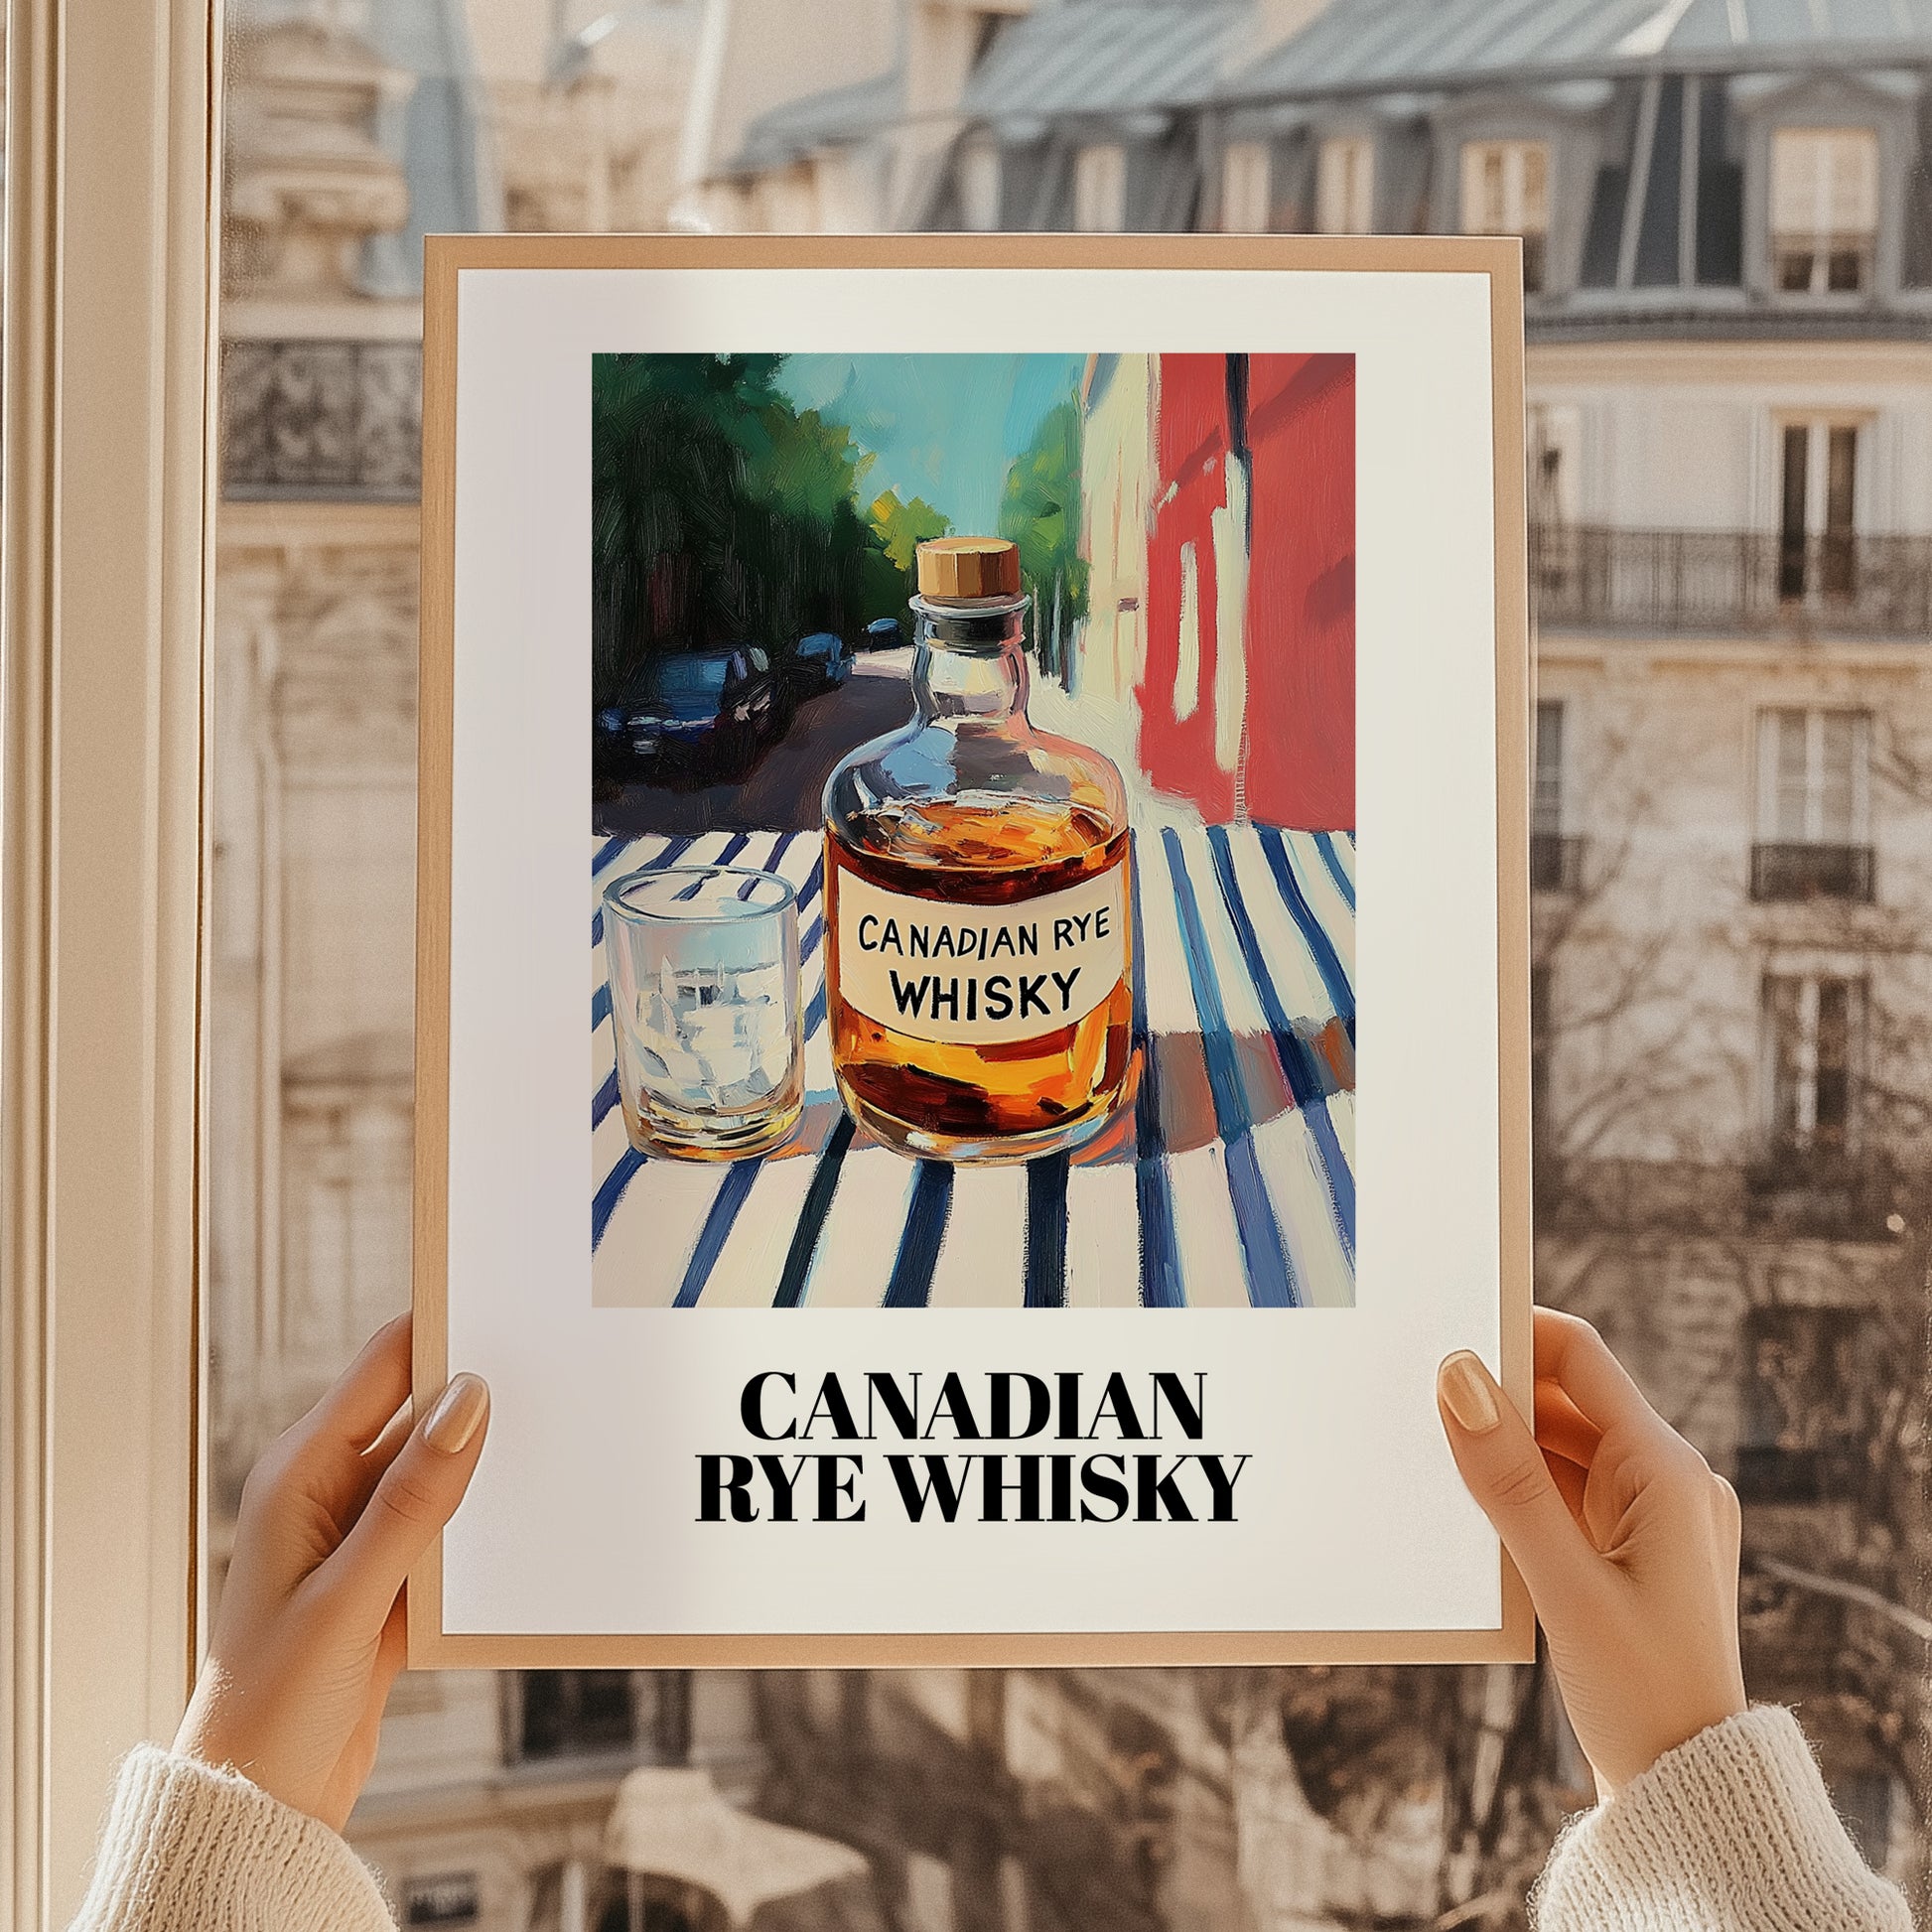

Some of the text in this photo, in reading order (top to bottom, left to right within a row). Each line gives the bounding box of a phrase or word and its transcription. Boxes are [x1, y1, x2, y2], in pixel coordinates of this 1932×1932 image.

[858, 905, 1110, 960] CANADIAN RYE
[889, 966, 1081, 1022] WHISKY
[740, 1371, 1208, 1441] CANADIAN
[694, 1454, 1254, 1523] RYE WHISKY
